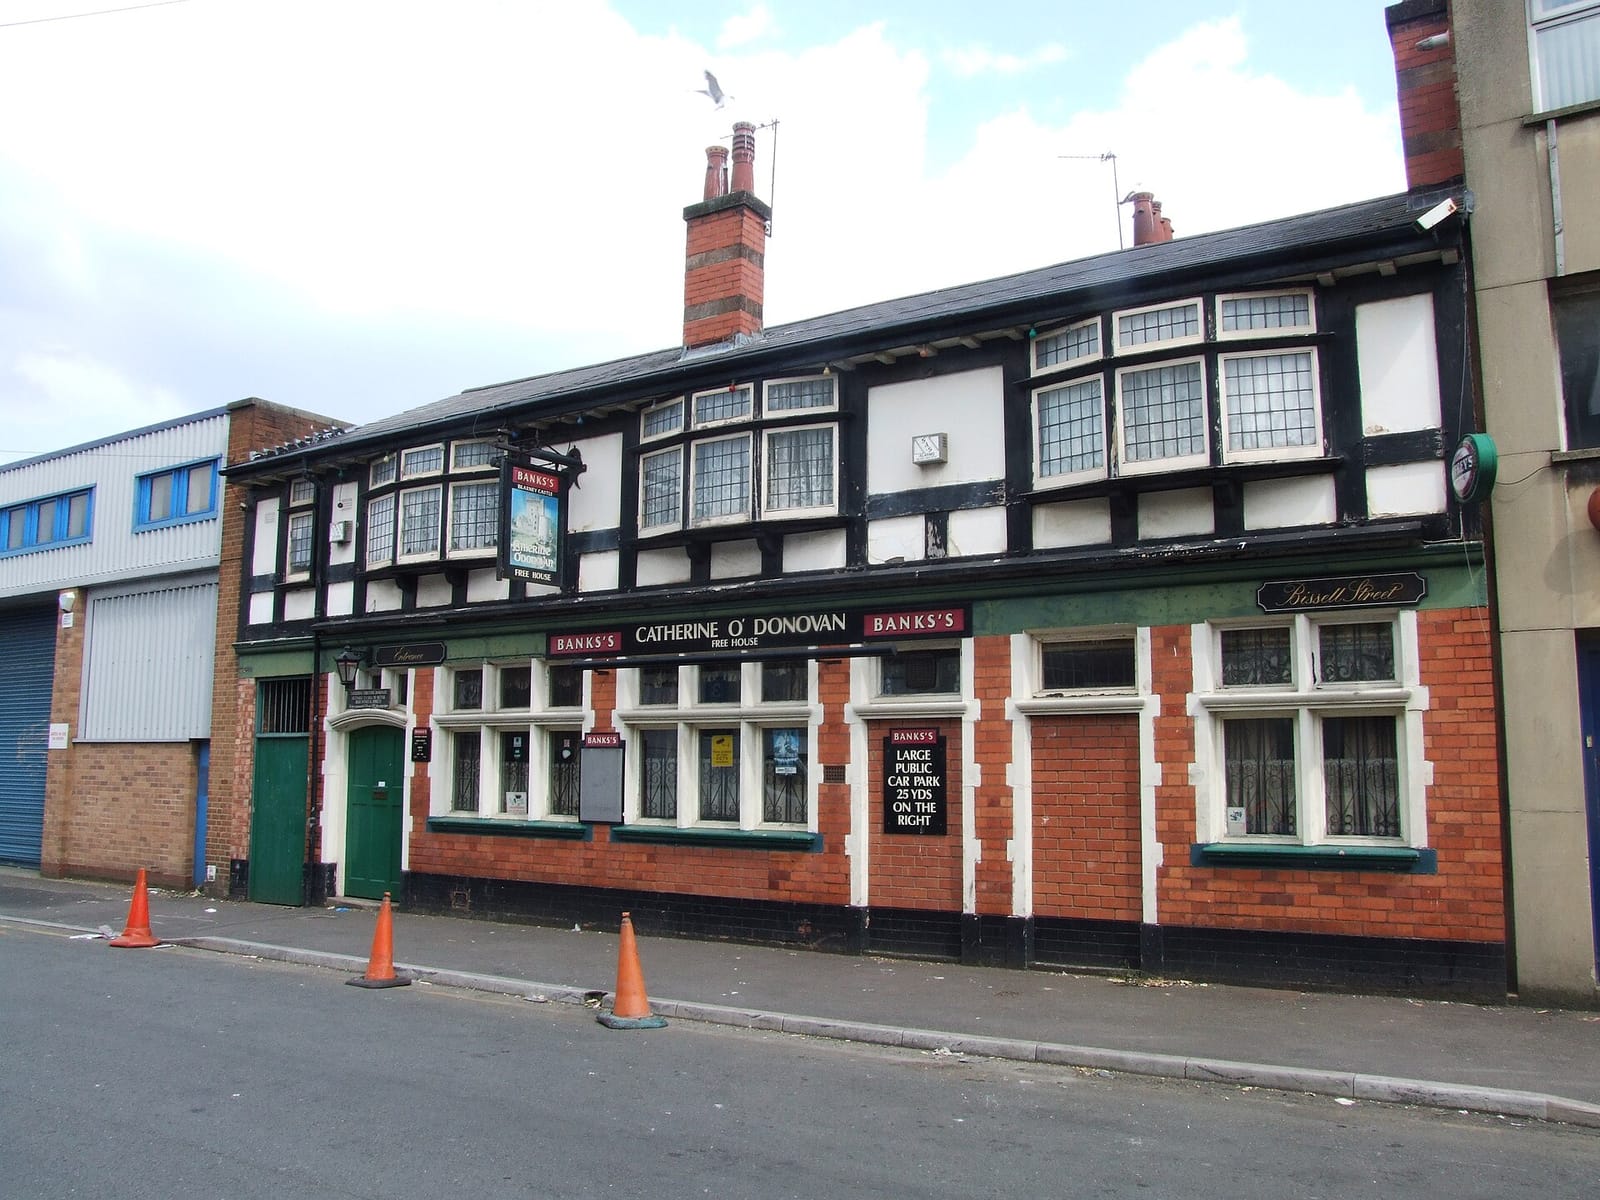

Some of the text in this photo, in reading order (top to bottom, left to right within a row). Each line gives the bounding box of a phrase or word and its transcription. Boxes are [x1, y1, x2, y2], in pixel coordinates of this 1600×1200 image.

[517, 471, 554, 488] BANKS'S
[514, 568, 552, 581] FREE HOUSE
[1276, 579, 1404, 606] Bissell Street
[635, 622, 719, 644] CATHERINE
[753, 613, 847, 635] DONOVAN
[873, 613, 955, 632] BANKS'S
[556, 634, 615, 651] BANKS'S
[711, 637, 759, 649] FREE HOUSE
[587, 736, 617, 744] BANKS'S
[893, 732, 933, 741] BANKS'S
[896, 749, 931, 761] LARGE
[895, 762, 933, 774] PUBLIC
[887, 775, 940, 787] CAR PARK
[896, 789, 932, 800] 25 YDS
[892, 801, 937, 813] ON THE
[897, 814, 932, 826] RIGHT
